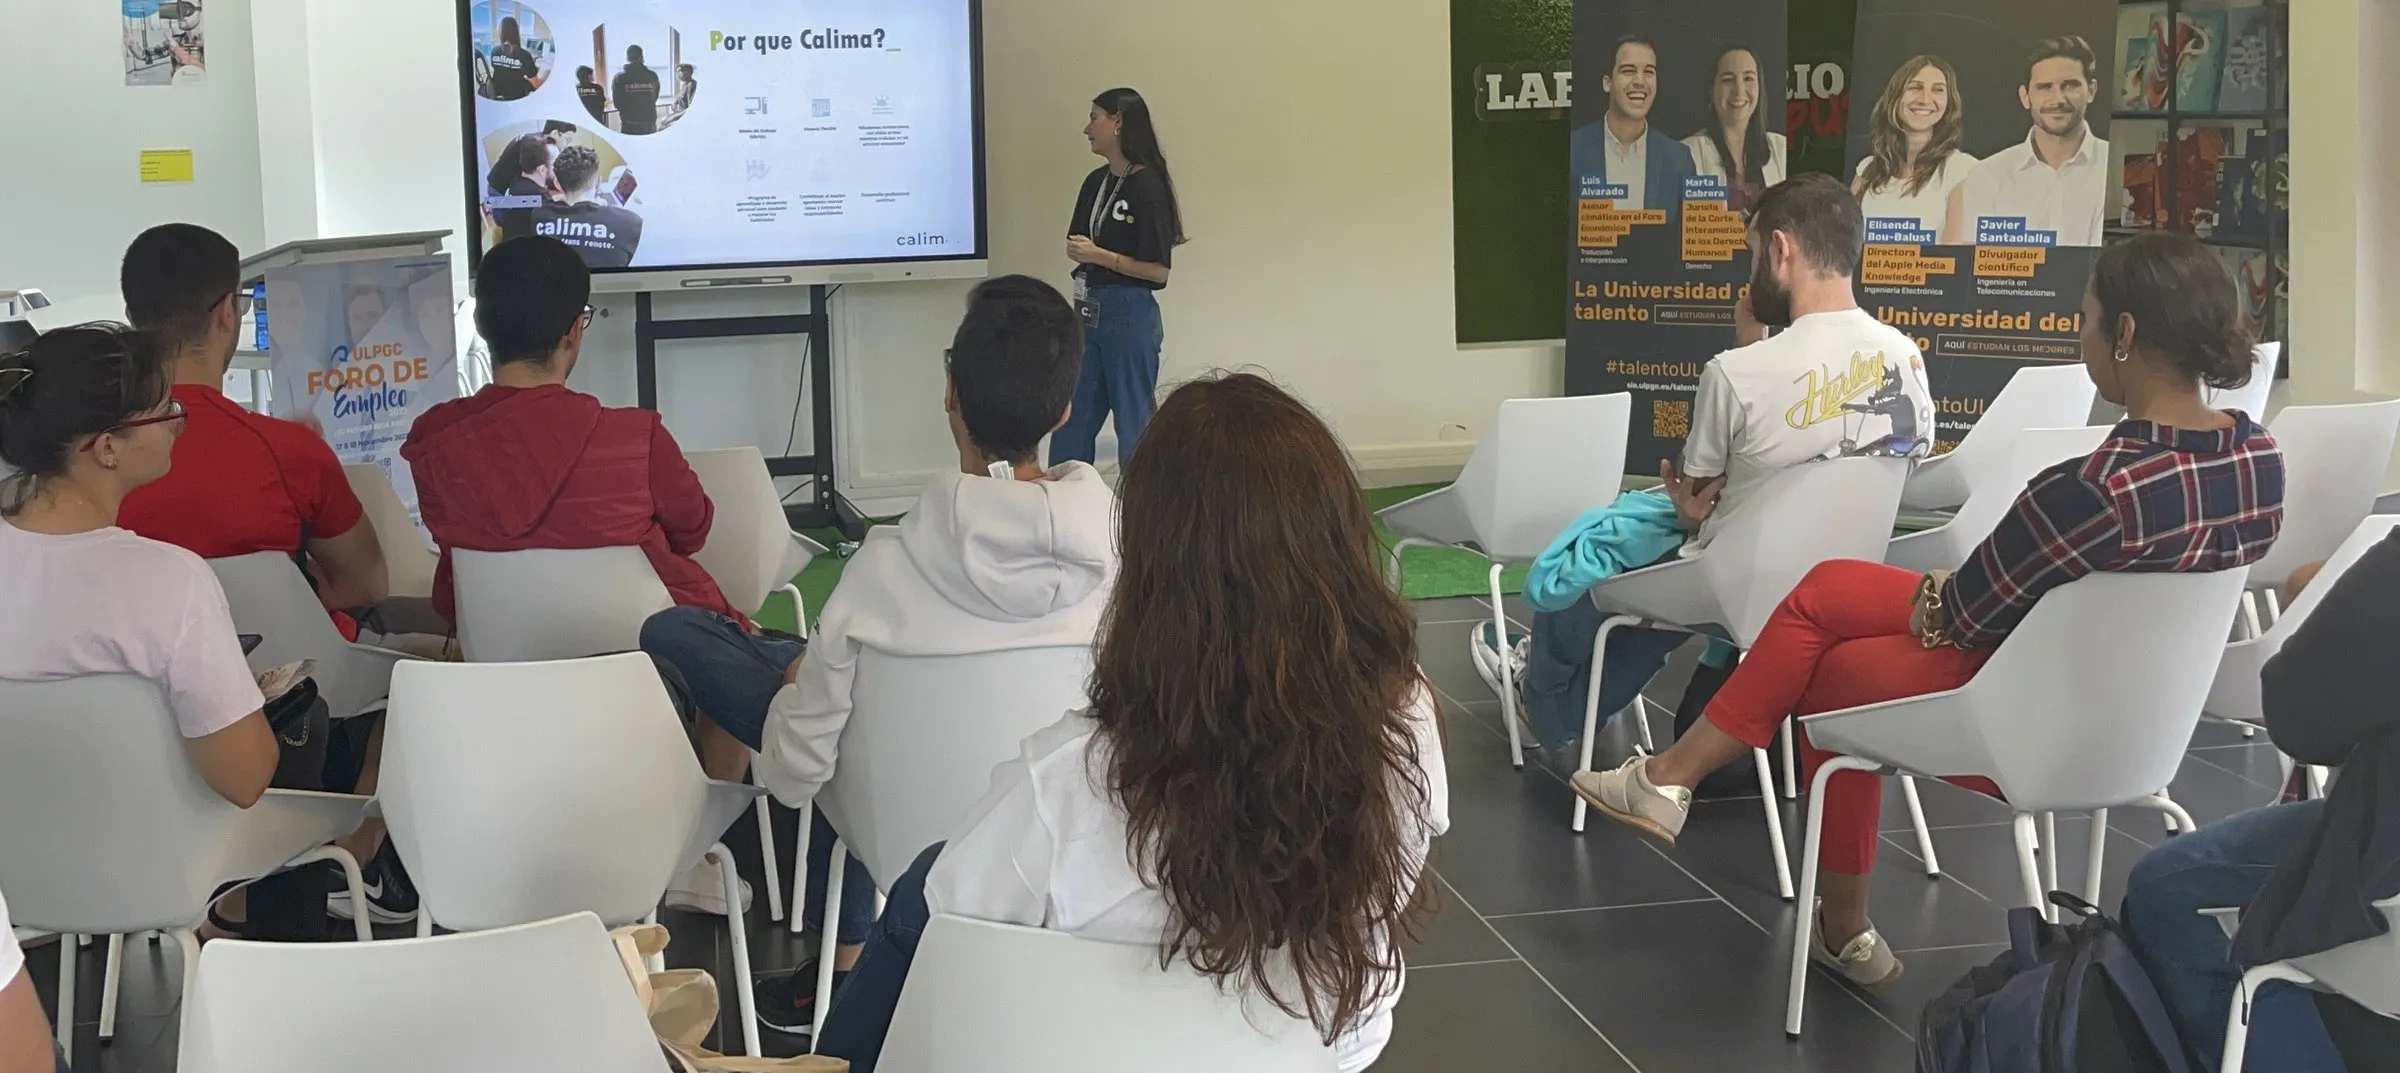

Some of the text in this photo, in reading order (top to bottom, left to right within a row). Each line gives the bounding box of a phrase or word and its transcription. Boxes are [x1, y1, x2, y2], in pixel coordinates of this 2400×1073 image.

[710, 31, 746, 51] Por
[754, 35, 792, 55] que
[1581, 176, 1600, 185] Luis
[1685, 178, 1714, 187] Marta
[1581, 187, 1624, 196] Alvarado
[1685, 189, 1725, 198] Cabrera
[1581, 212, 1619, 221] climático
[1634, 213, 1641, 221] el
[1642, 213, 1662, 221] Foro
[1686, 214, 1696, 222] de
[1699, 214, 1707, 222] la
[536, 217, 616, 239] calima.
[1686, 226, 1747, 234] Interamerica
[1869, 220, 1916, 230] Elisenda
[1980, 220, 2020, 230] Javier
[1580, 235, 1613, 243] Mundial
[1713, 238, 1746, 246] Derech
[1867, 232, 1932, 242] Bou-Balust
[1979, 233, 2050, 244] Santaolalla
[1685, 249, 1727, 257] Humanos
[1867, 248, 1916, 257] Directora
[1979, 250, 2040, 261] Divulgador
[1866, 260, 1946, 271] del Apple Media
[1978, 263, 2030, 273] científico
[1865, 273, 1921, 283] Knowledge
[1977, 278, 2015, 287] Ingeniería
[1575, 281, 1598, 298] La
[1604, 281, 1732, 300] Universidad
[1977, 287, 2056, 297] Telecomunicaciones
[1574, 303, 1650, 321] talento
[1660, 310, 1732, 320] AQUÍ ESTUDIAN LOS
[1877, 306, 2081, 333] Universidad del
[353, 343, 403, 361] ULPGC
[1944, 340, 2074, 355] AQUÍ ESTUDIAN LOS MEJORES
[1606, 360, 1700, 378] #talentoUL
[307, 357, 429, 395] FORO DE
[333, 381, 407, 421] Empleo
